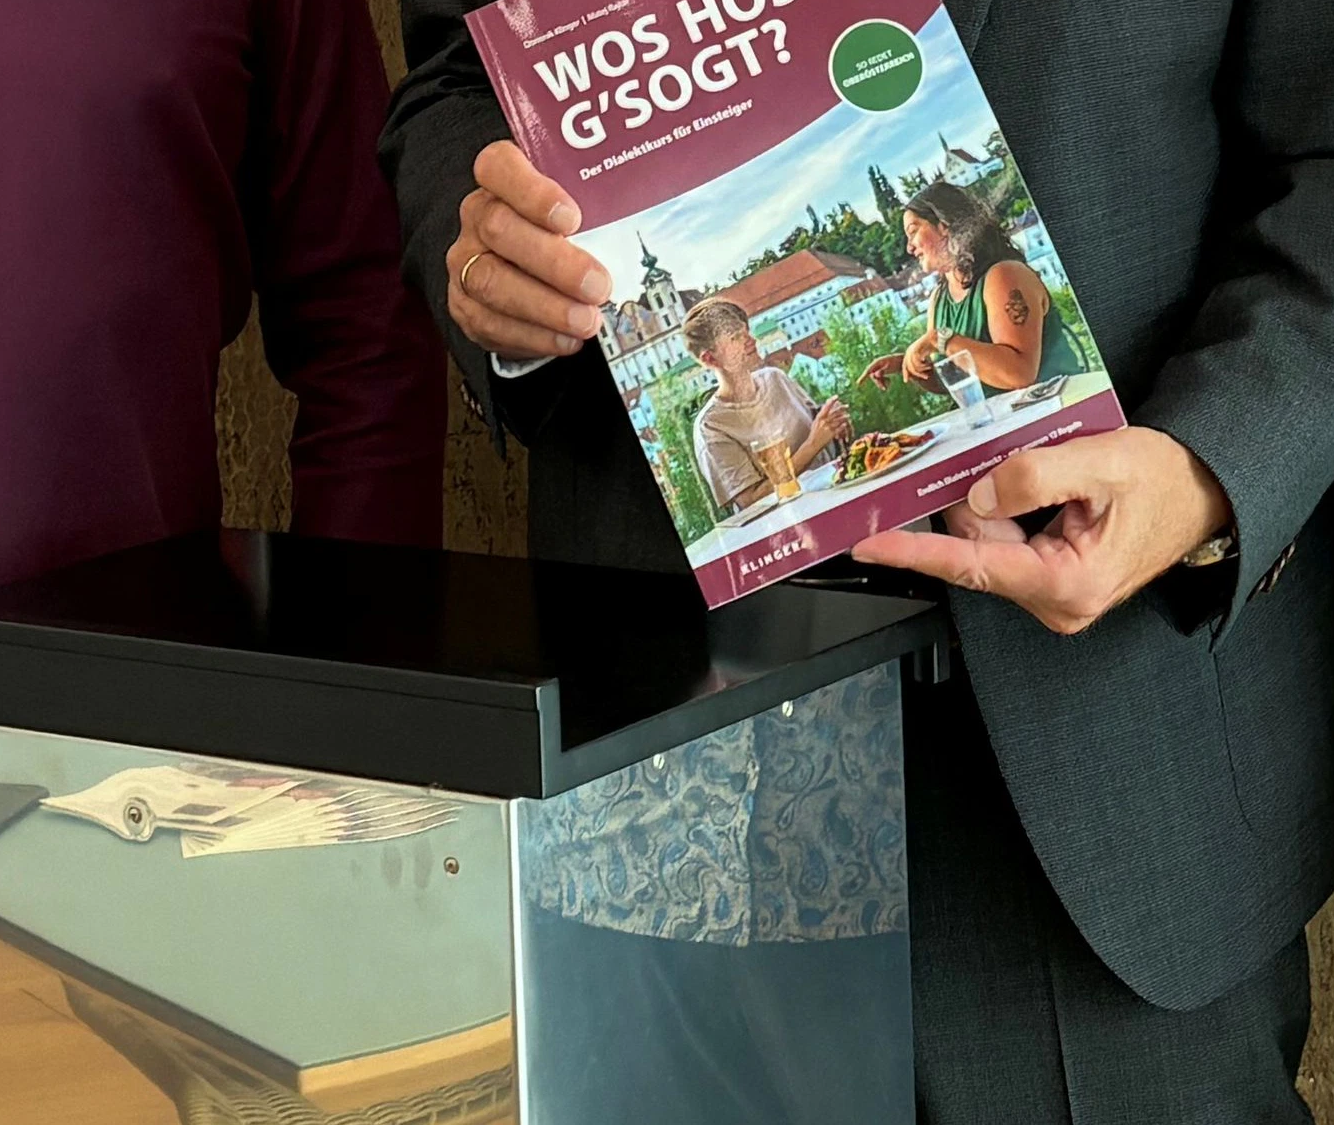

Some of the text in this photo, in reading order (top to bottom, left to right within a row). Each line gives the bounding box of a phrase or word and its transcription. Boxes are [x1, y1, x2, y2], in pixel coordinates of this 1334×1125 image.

[532, 13, 670, 102] WOS
[560, 18, 792, 150] G'SOGT?
[579, 99, 753, 180] Der Dialektkurs für Einsteiger
